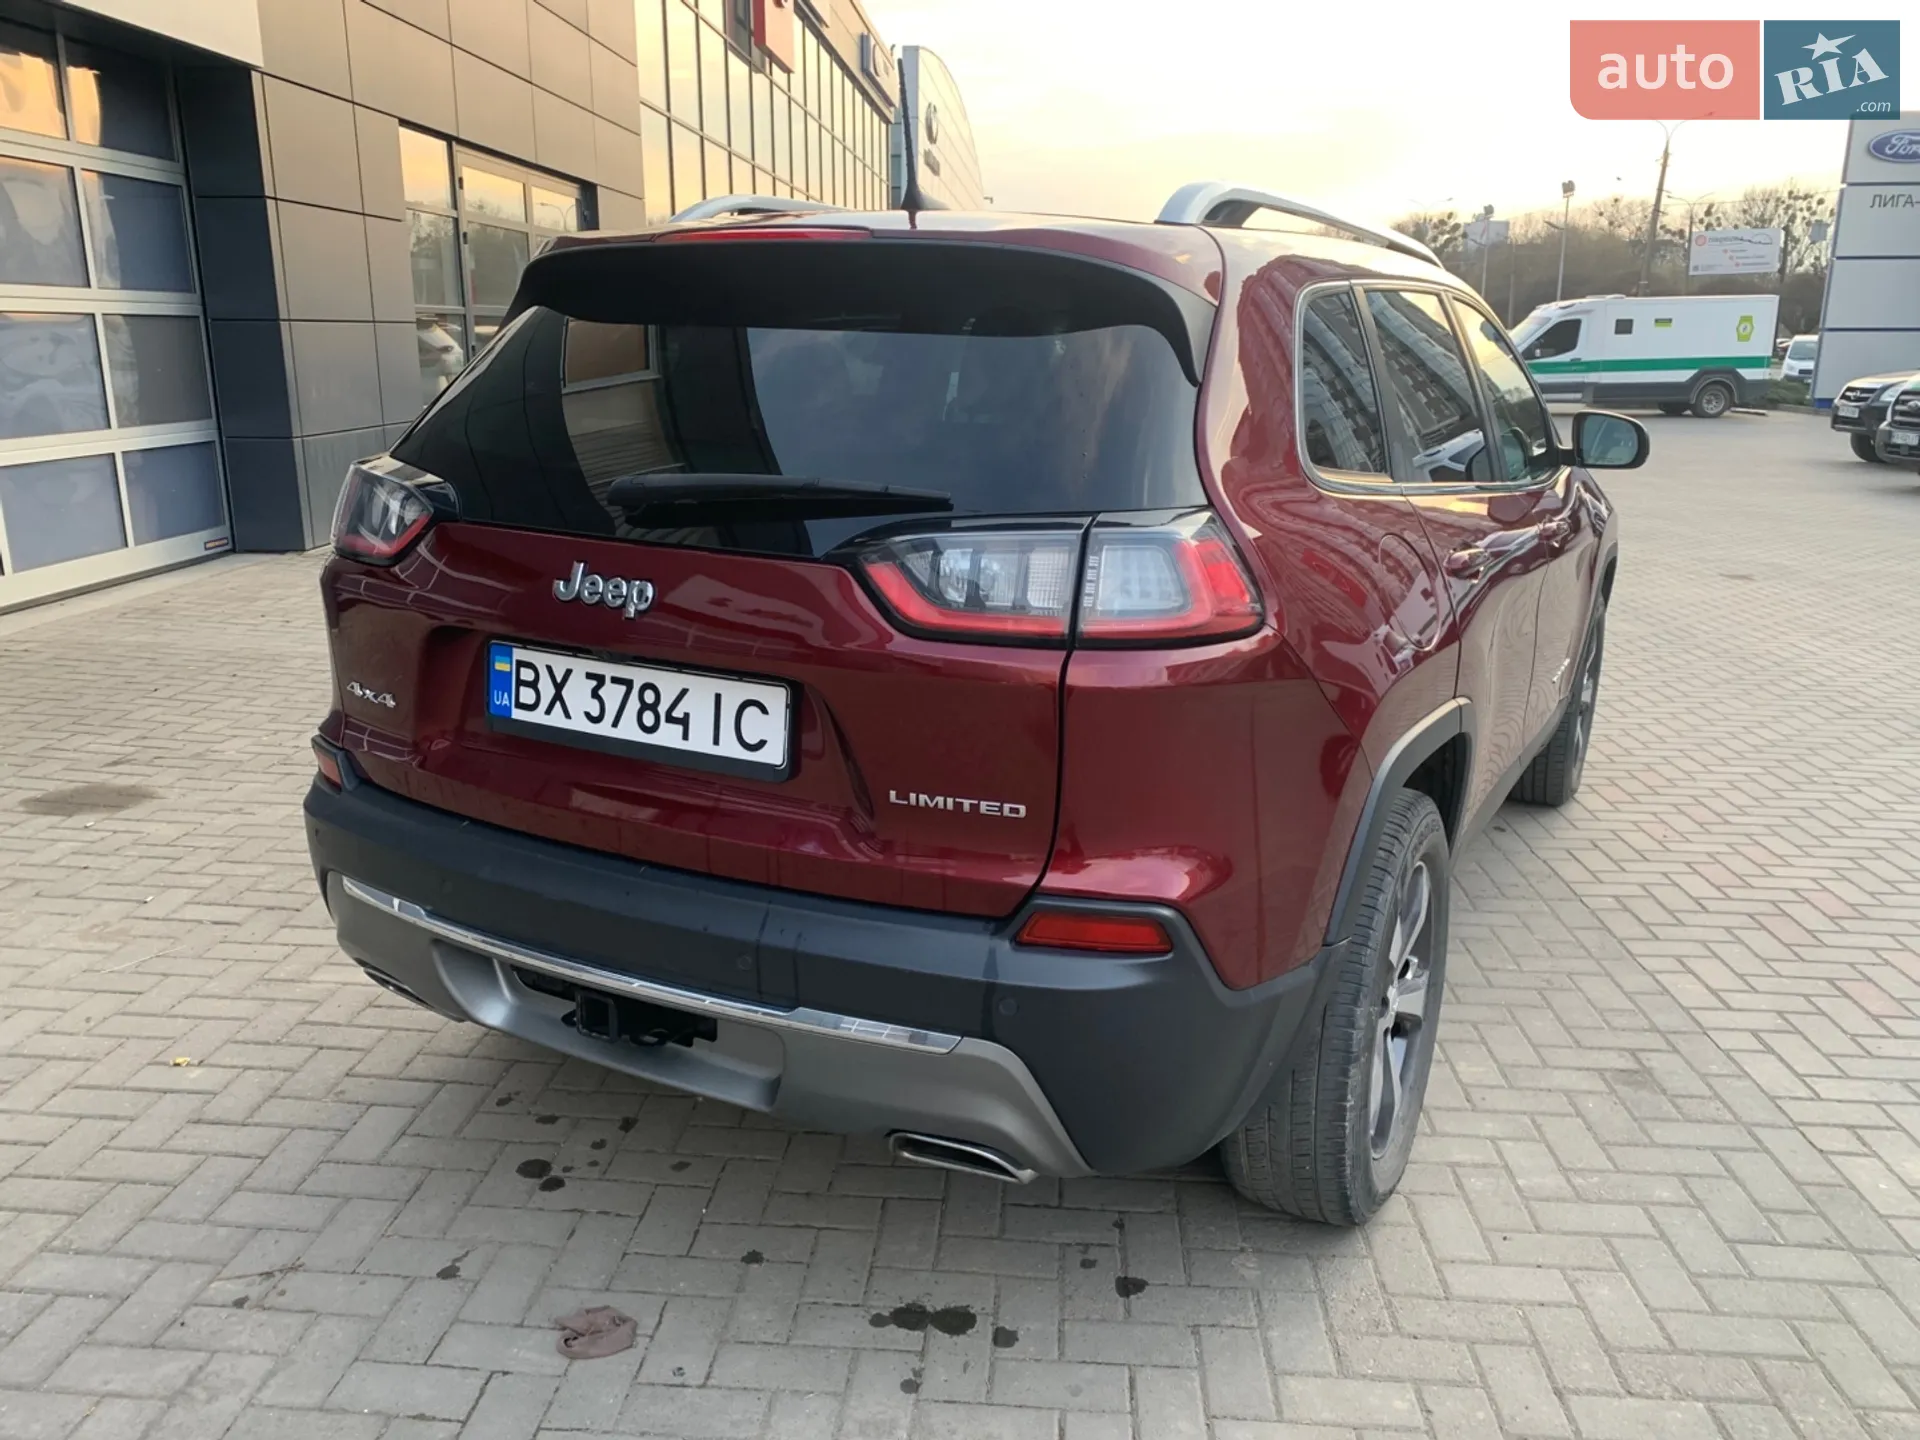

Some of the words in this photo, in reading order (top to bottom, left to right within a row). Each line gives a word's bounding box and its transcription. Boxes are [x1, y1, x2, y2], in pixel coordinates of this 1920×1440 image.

[1885, 134, 1920, 154] For
[553, 560, 656, 619] Jeep
[494, 690, 510, 708] UA
[514, 659, 572, 720] BX
[584, 672, 690, 742] 3784
[713, 693, 770, 752] IC
[889, 789, 1026, 819] LIMITED
